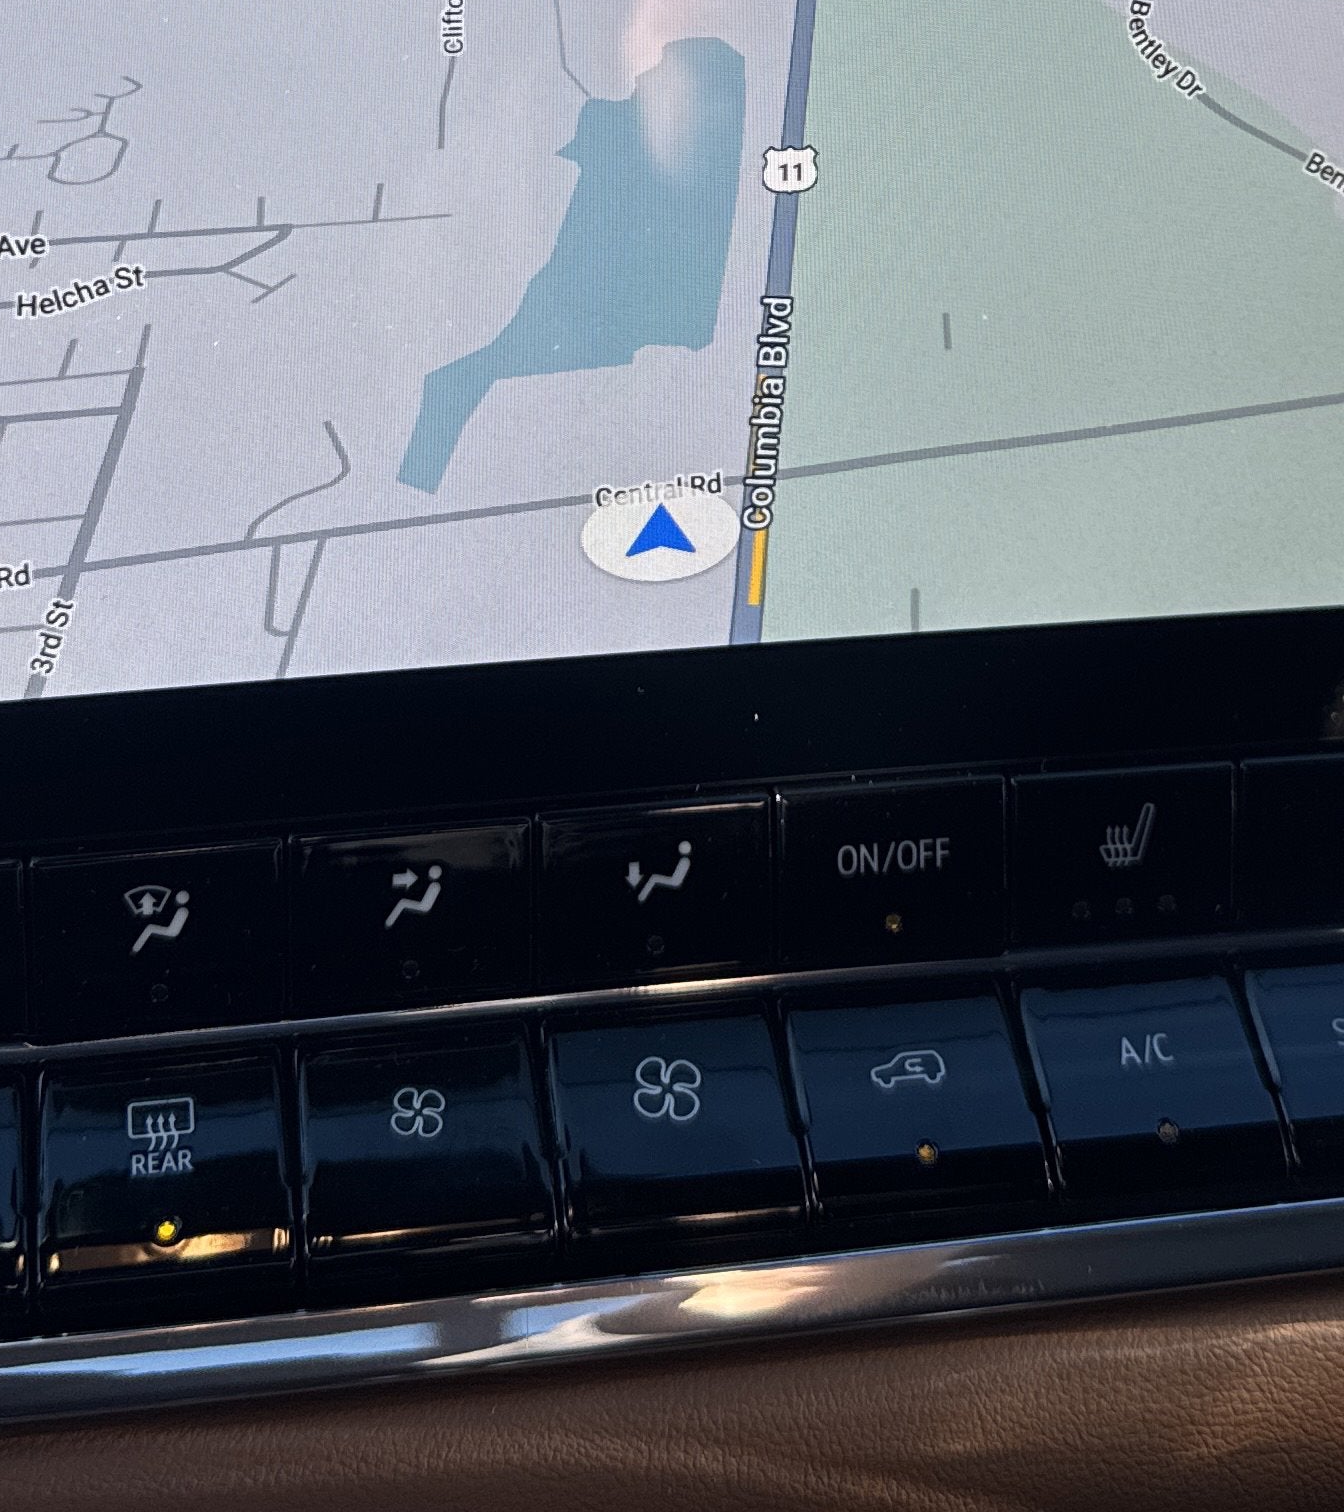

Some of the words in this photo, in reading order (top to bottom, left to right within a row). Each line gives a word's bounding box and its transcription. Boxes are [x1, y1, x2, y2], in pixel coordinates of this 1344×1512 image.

[1129, 0, 1177, 80] Bentley
[1176, 69, 1204, 97] Dr
[778, 164, 802, 181] 11
[16, 280, 109, 318] Helcha
[115, 266, 144, 289] St
[756, 296, 793, 369] Blvd
[743, 376, 786, 530] Columbia
[690, 472, 721, 494] Rd
[30, 632, 64, 674] 3rd
[47, 602, 74, 629] St
[838, 837, 950, 876] ON/OFF
[1120, 1034, 1174, 1066] A/C
[130, 1149, 193, 1177] REAR
